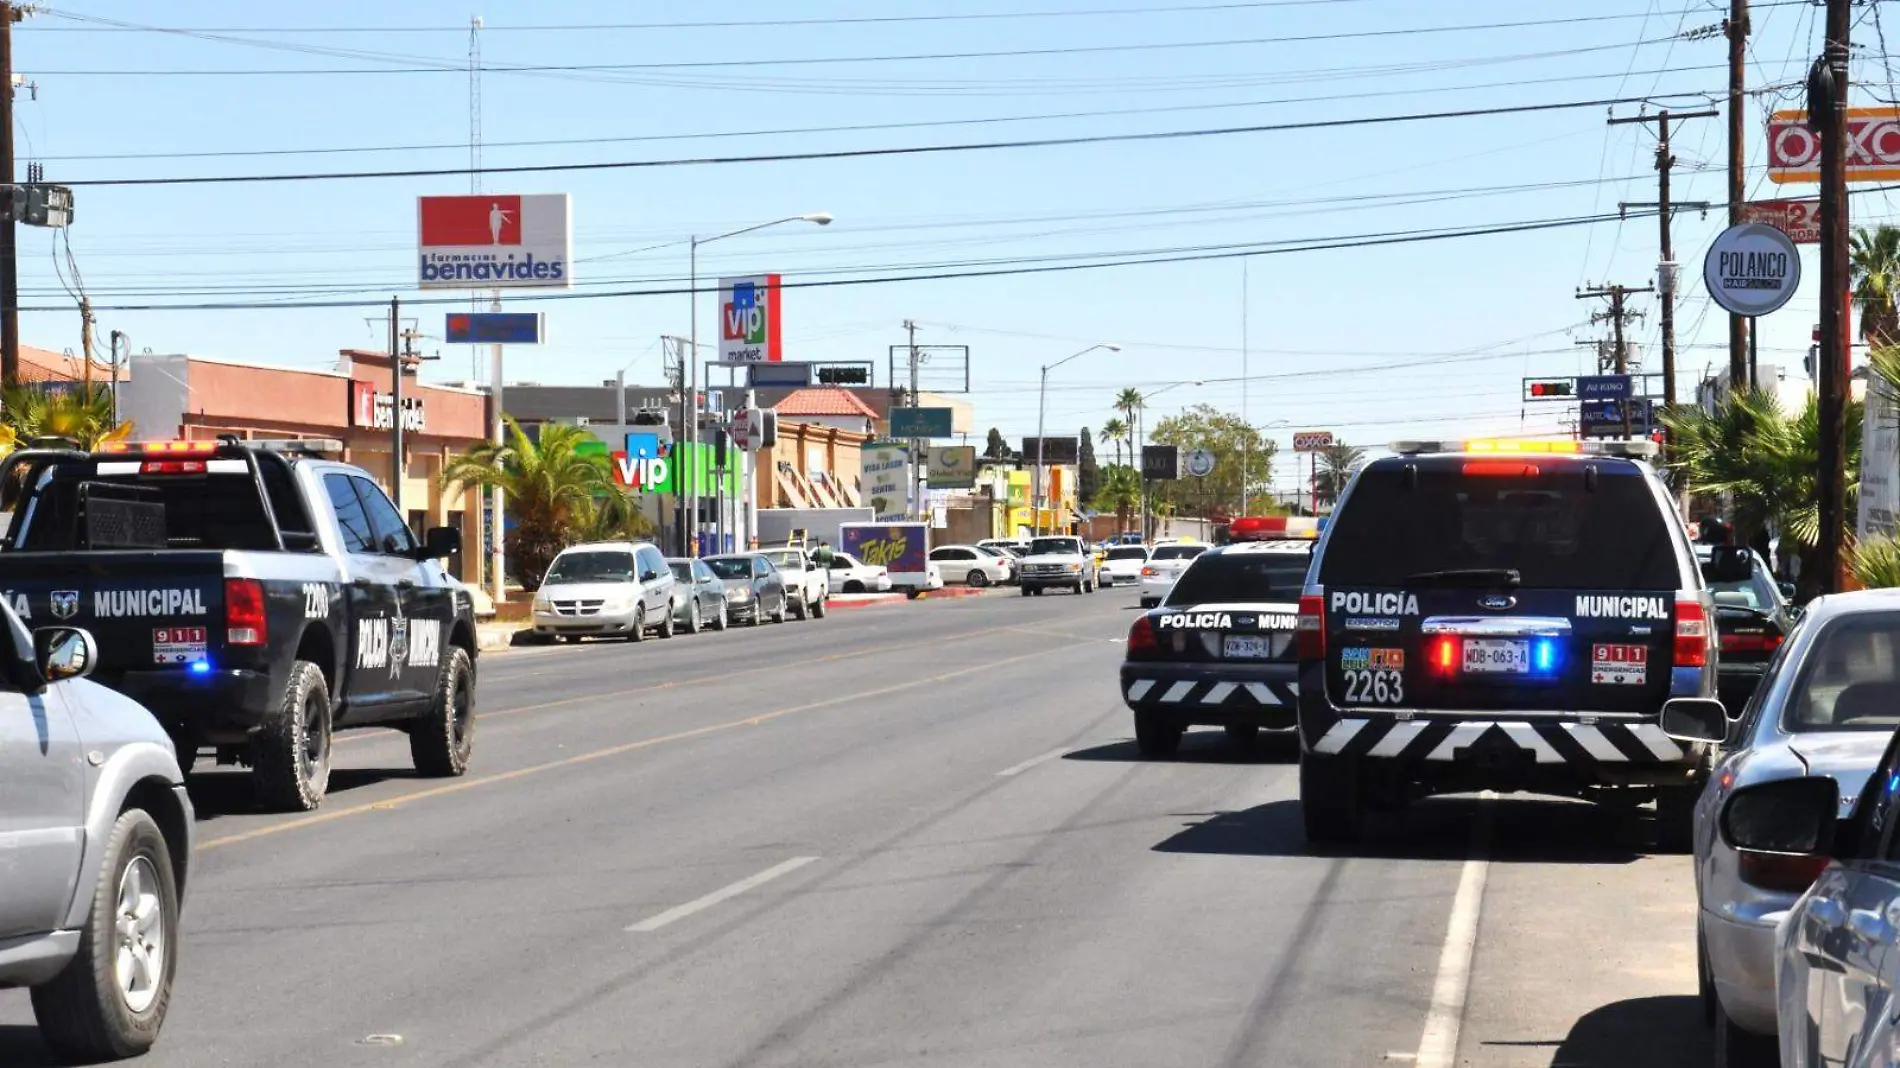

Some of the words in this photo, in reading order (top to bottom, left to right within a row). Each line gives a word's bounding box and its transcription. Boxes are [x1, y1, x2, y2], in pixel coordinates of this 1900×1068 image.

[1775, 122, 1900, 166] OXO
[421, 252, 562, 281] benavides
[431, 253, 496, 262] farmacias
[1720, 251, 1787, 278] POLANCO
[728, 298, 762, 341] vip
[728, 347, 762, 361] market
[1294, 435, 1332, 448] OXXO
[617, 448, 668, 491] vip
[94, 589, 207, 618] MUNICIPAL
[1331, 590, 1419, 616] POLICÍA
[1576, 595, 1668, 619] MUNICIPAL
[1159, 612, 1233, 629] POLICÍA
[1598, 647, 1641, 661] 911
[1344, 669, 1404, 703] 2263
